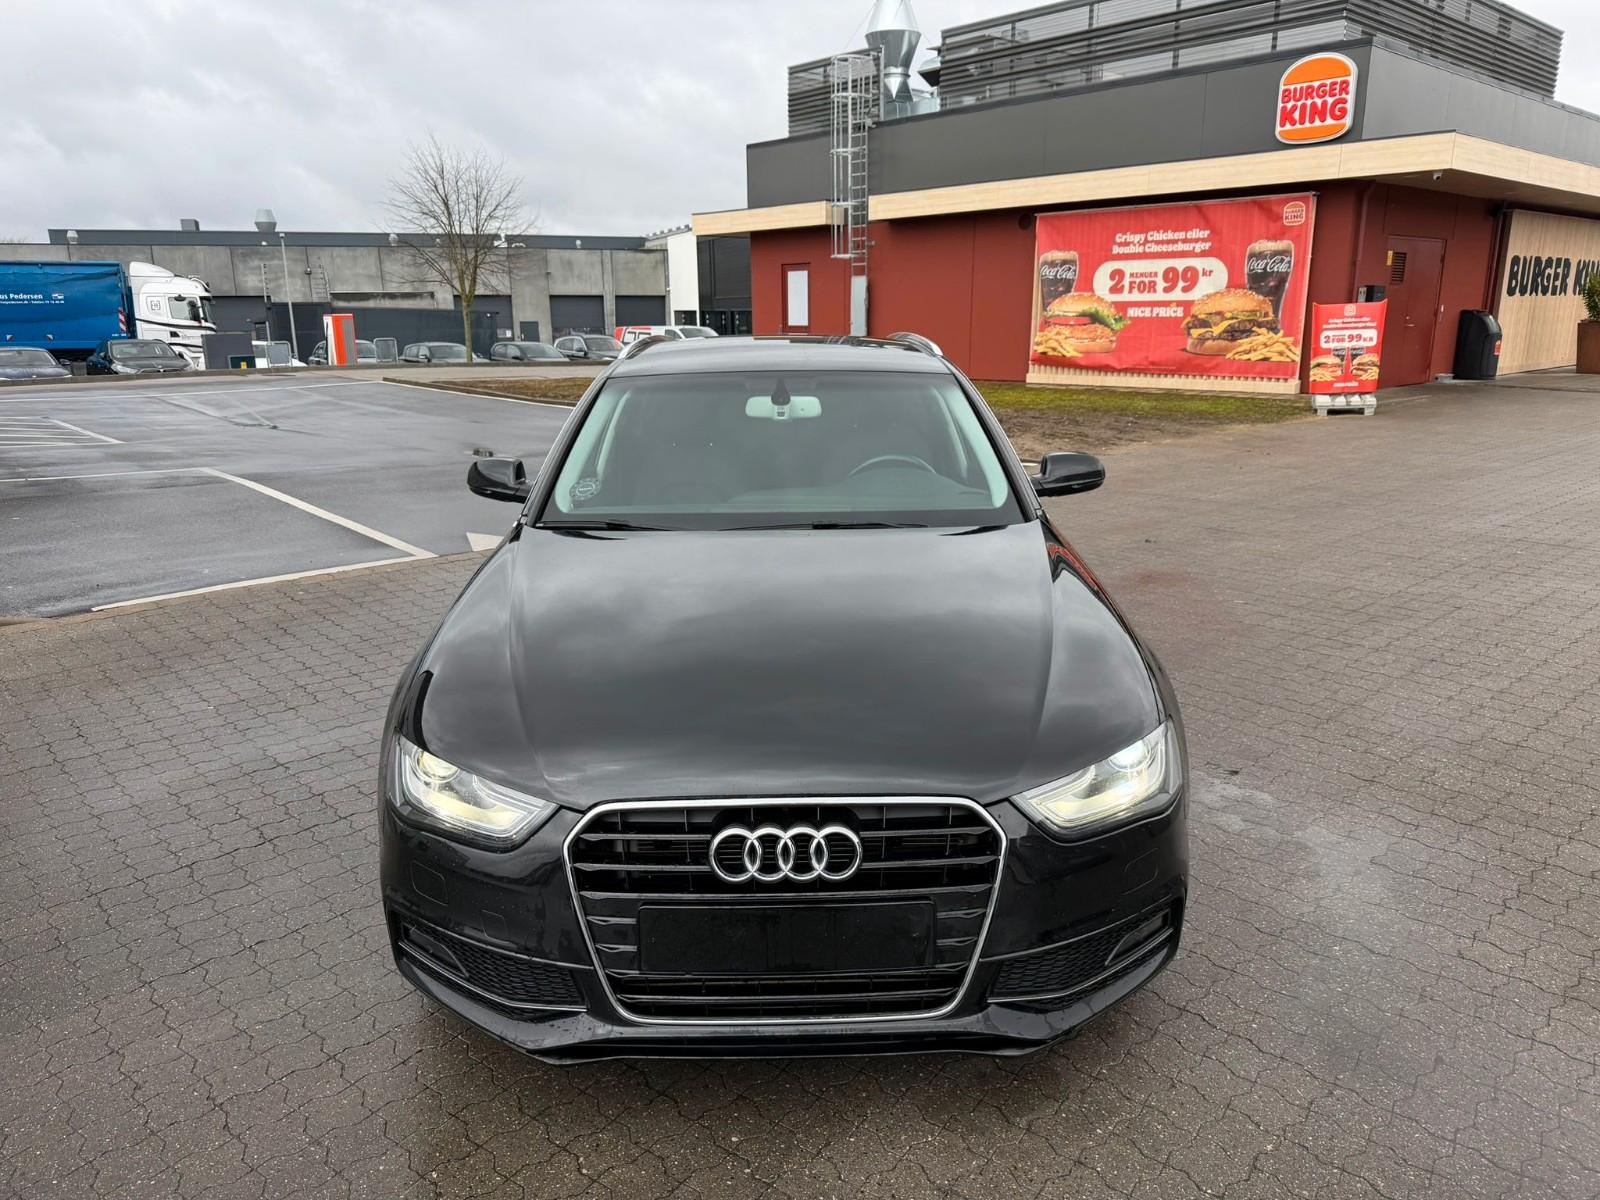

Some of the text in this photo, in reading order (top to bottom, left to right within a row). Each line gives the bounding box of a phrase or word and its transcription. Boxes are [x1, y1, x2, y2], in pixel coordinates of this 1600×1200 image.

[1281, 79, 1350, 104] BURGER
[1279, 97, 1348, 128] KING
[1285, 213, 1304, 221] KING
[1115, 228, 1211, 244] Crispy Chicken eller
[1112, 241, 1212, 254] Double Cheeseburger
[1248, 254, 1292, 273] Coca-Cola
[1109, 268, 1125, 294] 2
[1128, 280, 1157, 294] FOR
[1162, 265, 1200, 294] 99
[1202, 268, 1214, 277] kr
[1507, 254, 1571, 296] BURGER
[1127, 306, 1184, 317] NICE PRICE
[1323, 335, 1331, 344] 2
[1347, 333, 1363, 343] 99
